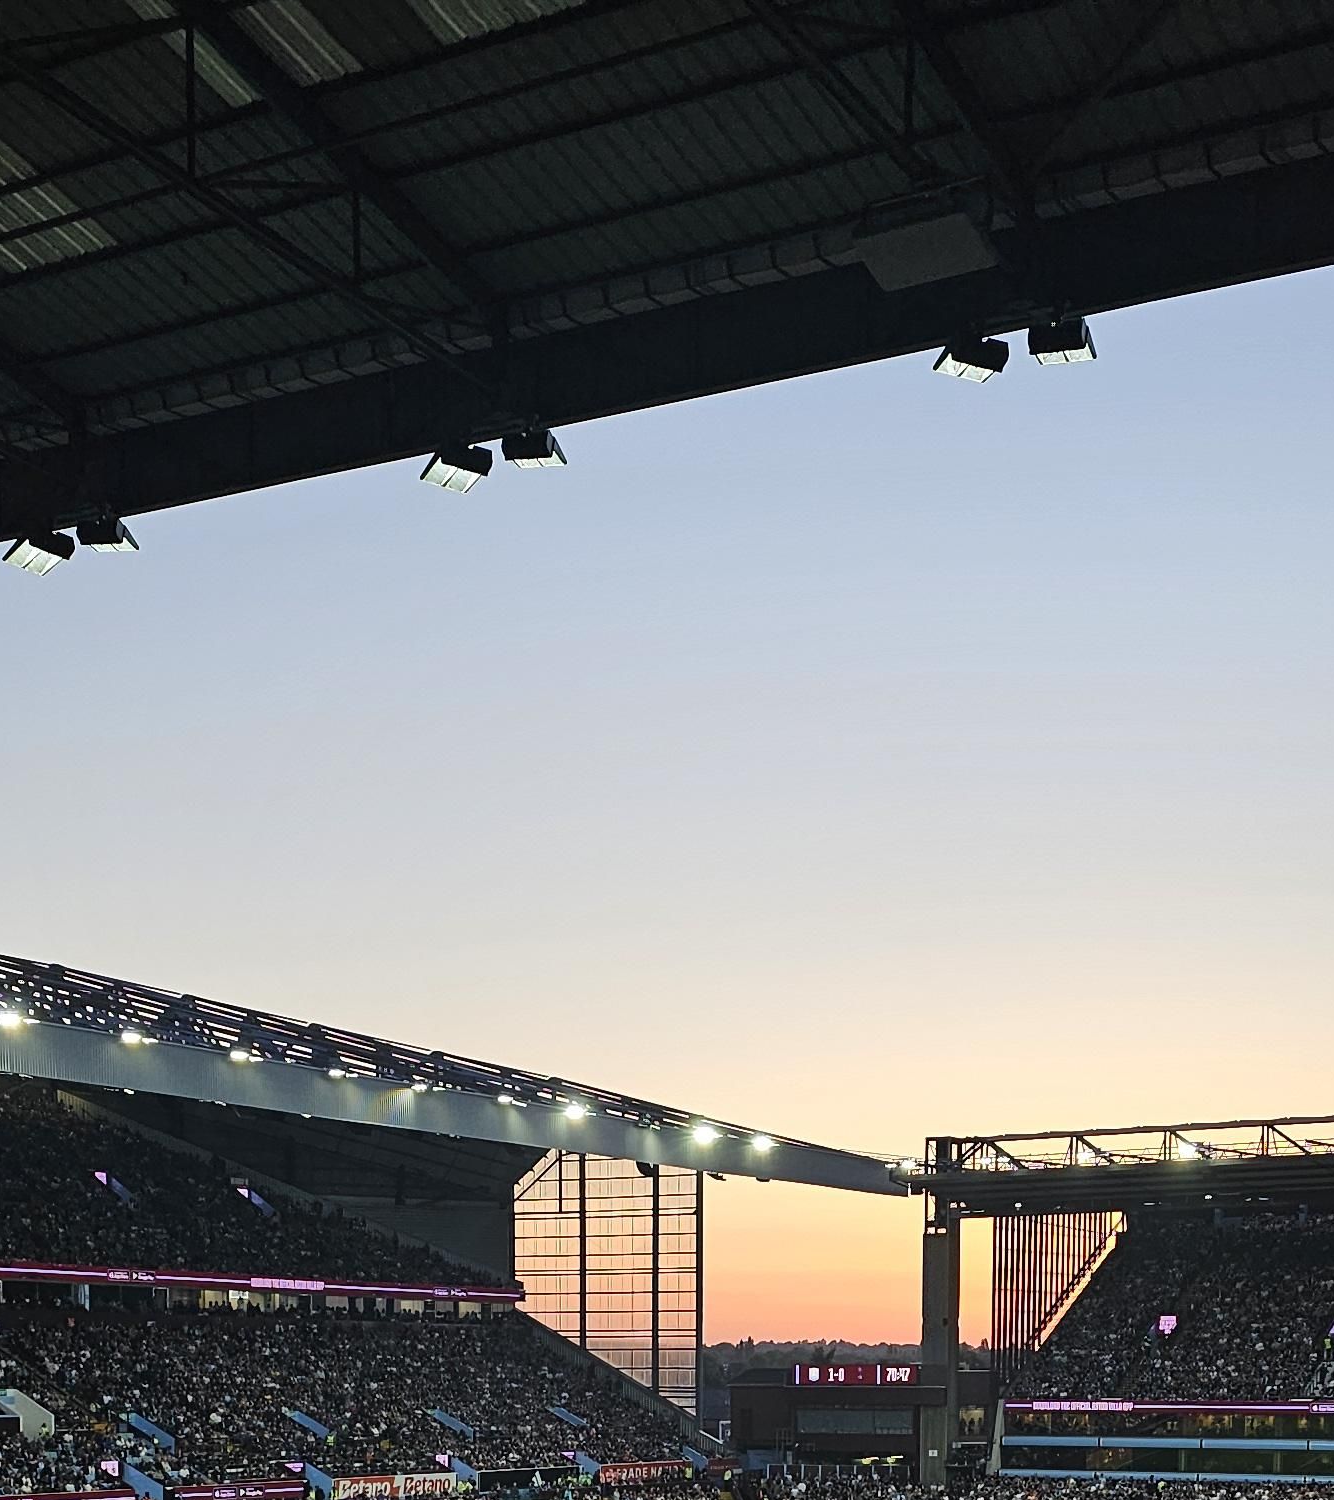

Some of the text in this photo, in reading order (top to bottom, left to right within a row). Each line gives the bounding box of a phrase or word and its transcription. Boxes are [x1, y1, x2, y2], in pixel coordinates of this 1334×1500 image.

[886, 1367, 911, 1382] 70:47
[339, 1476, 451, 1500] Betano Betano
